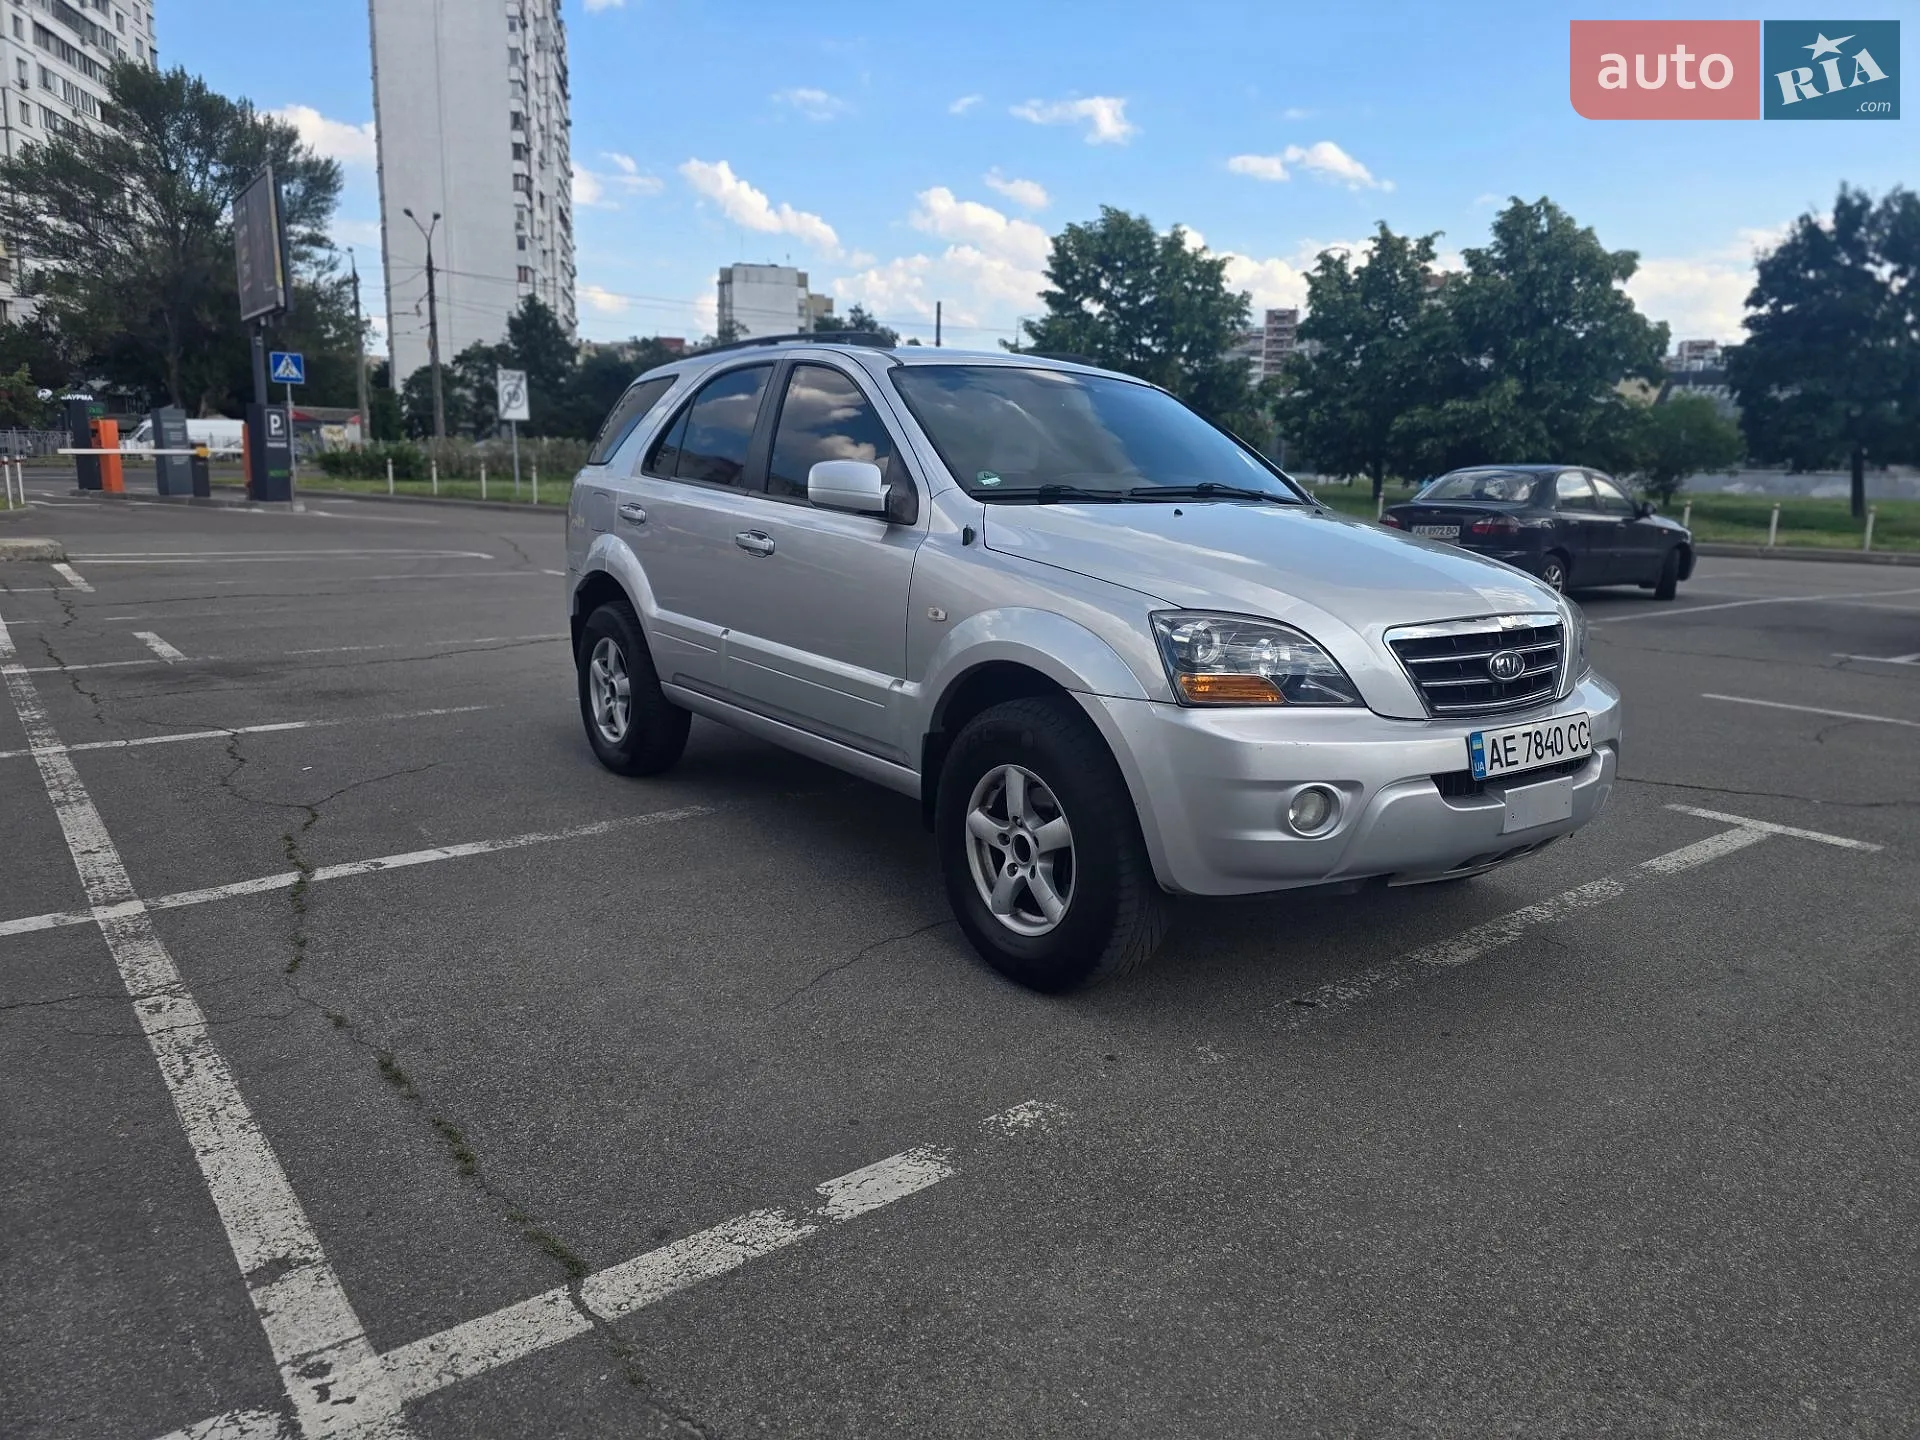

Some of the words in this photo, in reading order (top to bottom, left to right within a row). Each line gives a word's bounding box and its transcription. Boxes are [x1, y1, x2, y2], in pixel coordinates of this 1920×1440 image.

[269, 414, 281, 436] P
[1495, 657, 1520, 673] KIA
[1489, 734, 1519, 770] AE
[1522, 726, 1564, 763] 7840
[1567, 721, 1589, 752] CC
[1475, 761, 1485, 772] UA
